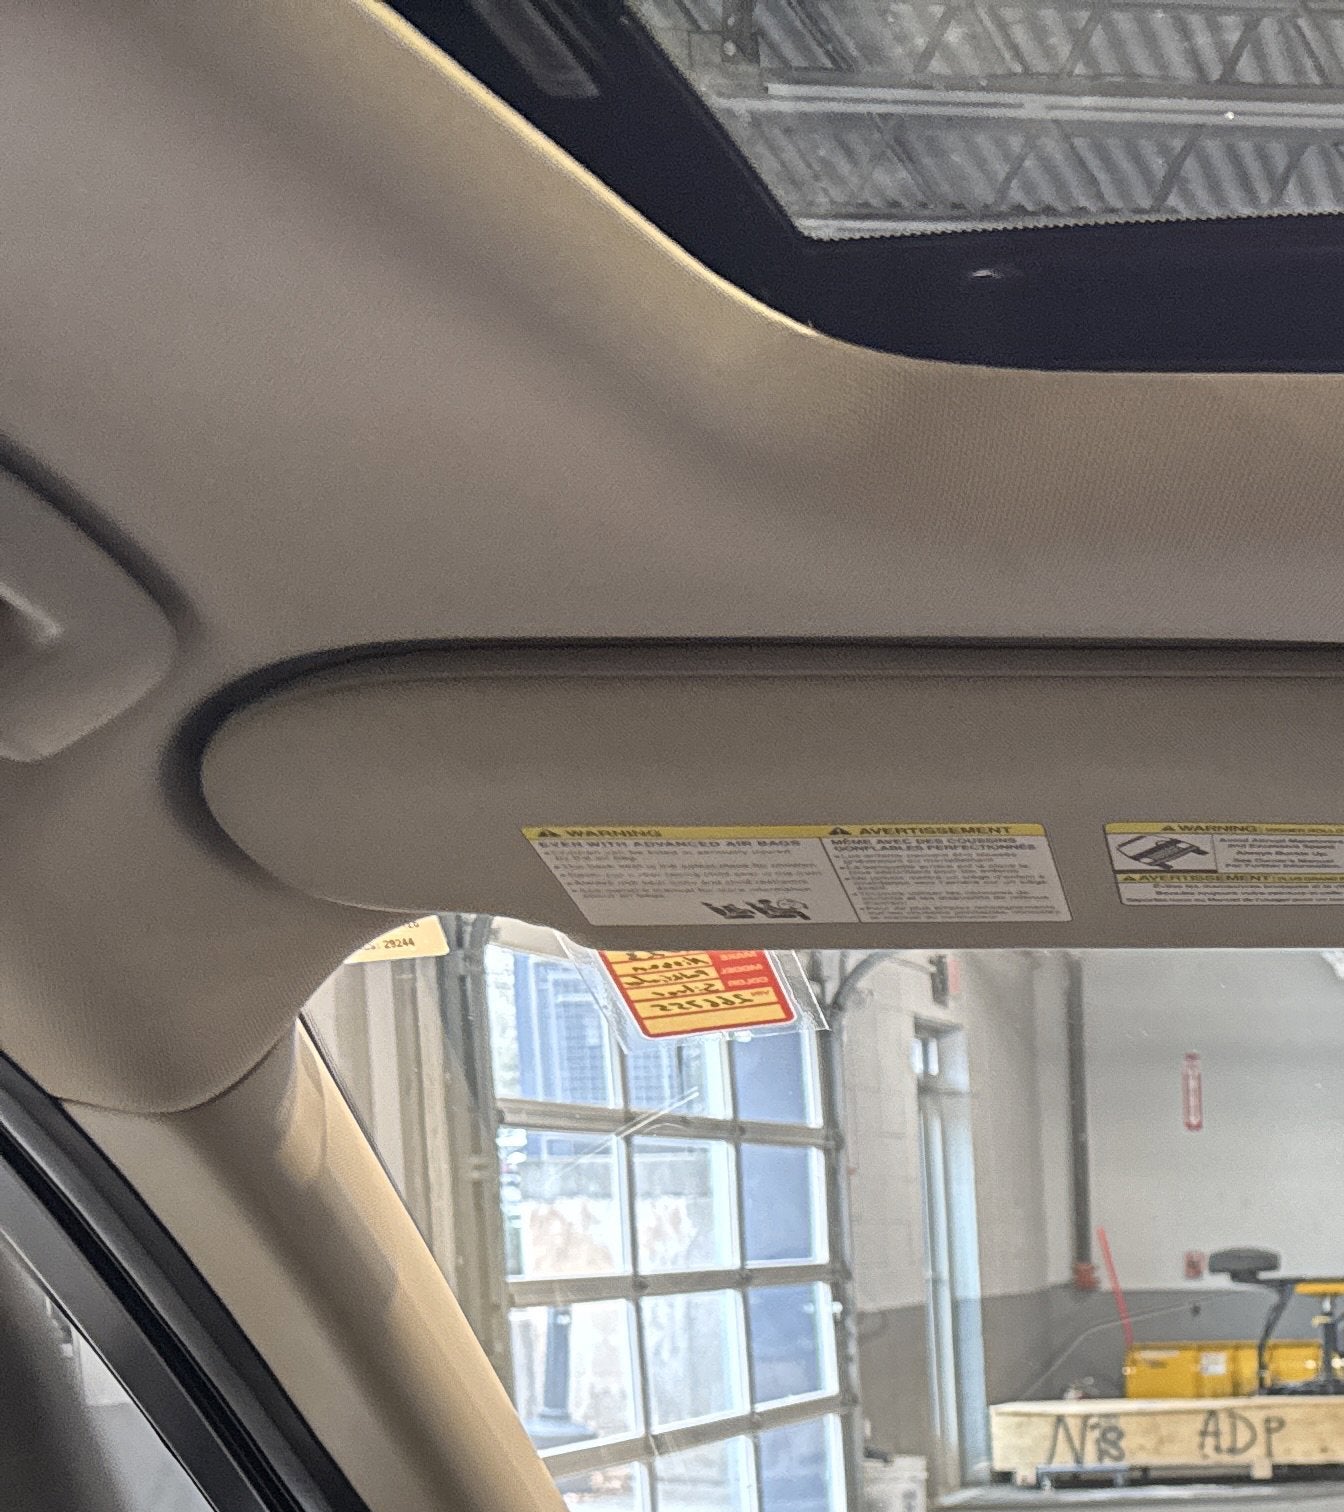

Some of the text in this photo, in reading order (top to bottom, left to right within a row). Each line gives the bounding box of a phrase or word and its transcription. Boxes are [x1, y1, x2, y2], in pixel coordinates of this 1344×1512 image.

[566, 829, 662, 838] WARNING
[860, 826, 1012, 836] AVERTISSEMENT
[383, 938, 416, 949] 29244
[1199, 1409, 1286, 1458] ADP
